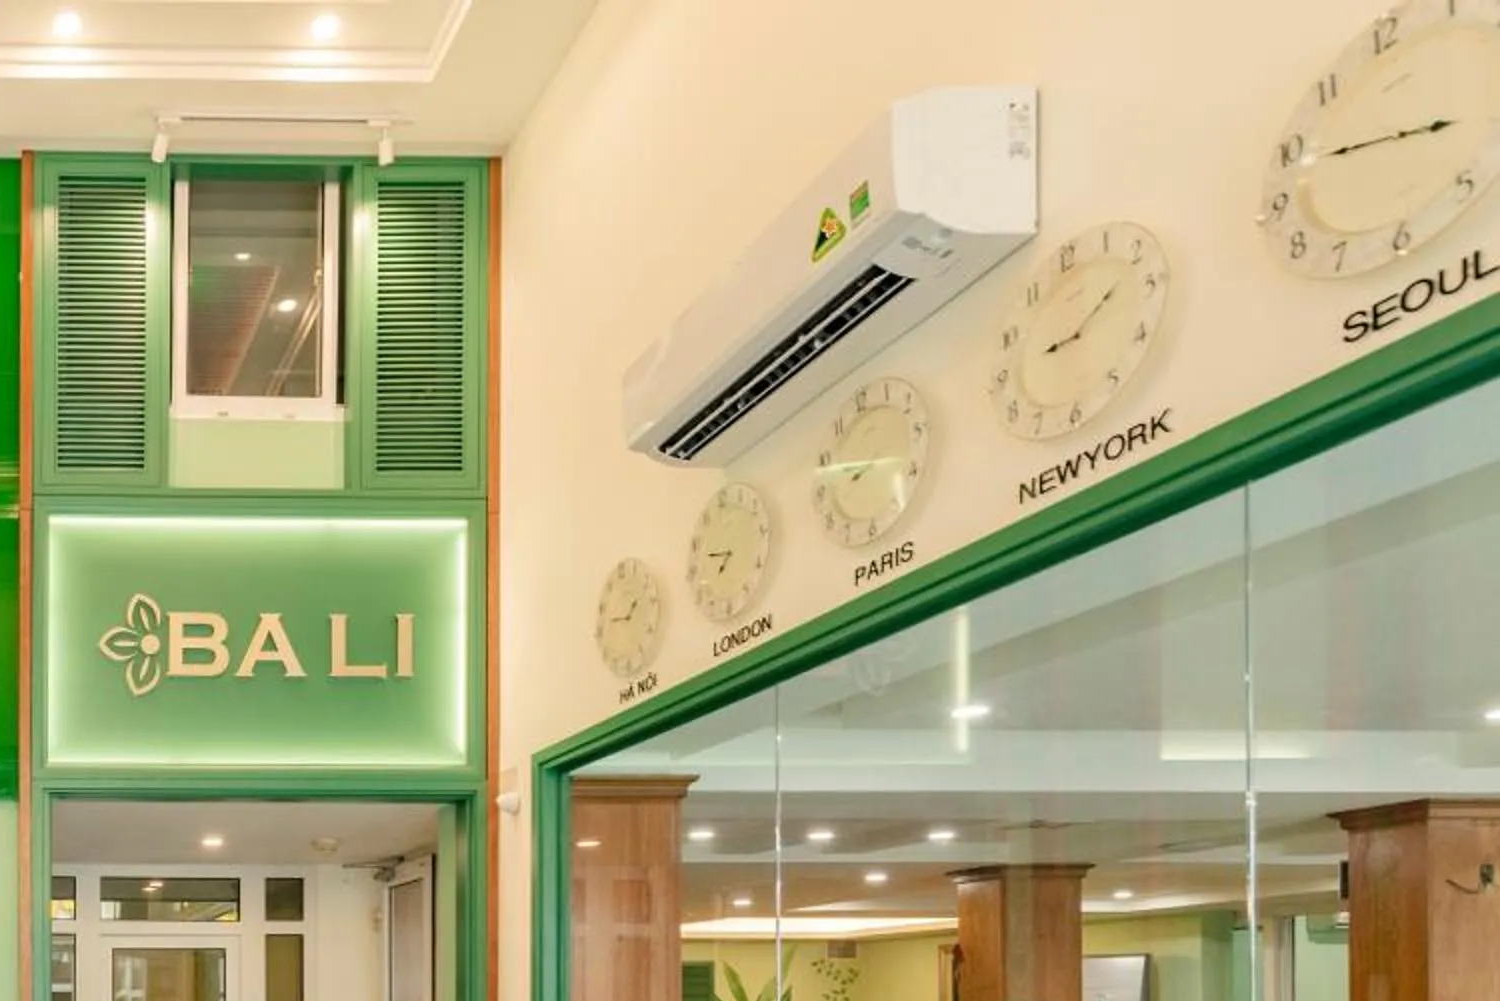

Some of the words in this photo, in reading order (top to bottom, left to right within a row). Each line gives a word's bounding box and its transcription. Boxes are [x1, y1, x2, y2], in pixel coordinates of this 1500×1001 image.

[1372, 17, 1397, 55] 12
[1317, 73, 1338, 106] 11
[1279, 134, 1304, 168] 10
[1455, 169, 1474, 203] 5
[1271, 192, 1289, 221] 9
[1102, 231, 1109, 252] 1
[1290, 231, 1307, 259] 8
[1392, 221, 1411, 251] 6
[1332, 240, 1347, 272] 7
[1027, 282, 1039, 307] 11
[1342, 250, 1500, 343] SEOUL
[1033, 410, 1044, 435] 7
[1018, 407, 1172, 504] NEWYORK
[854, 541, 915, 587] PARIS
[712, 613, 773, 657] LONDON
